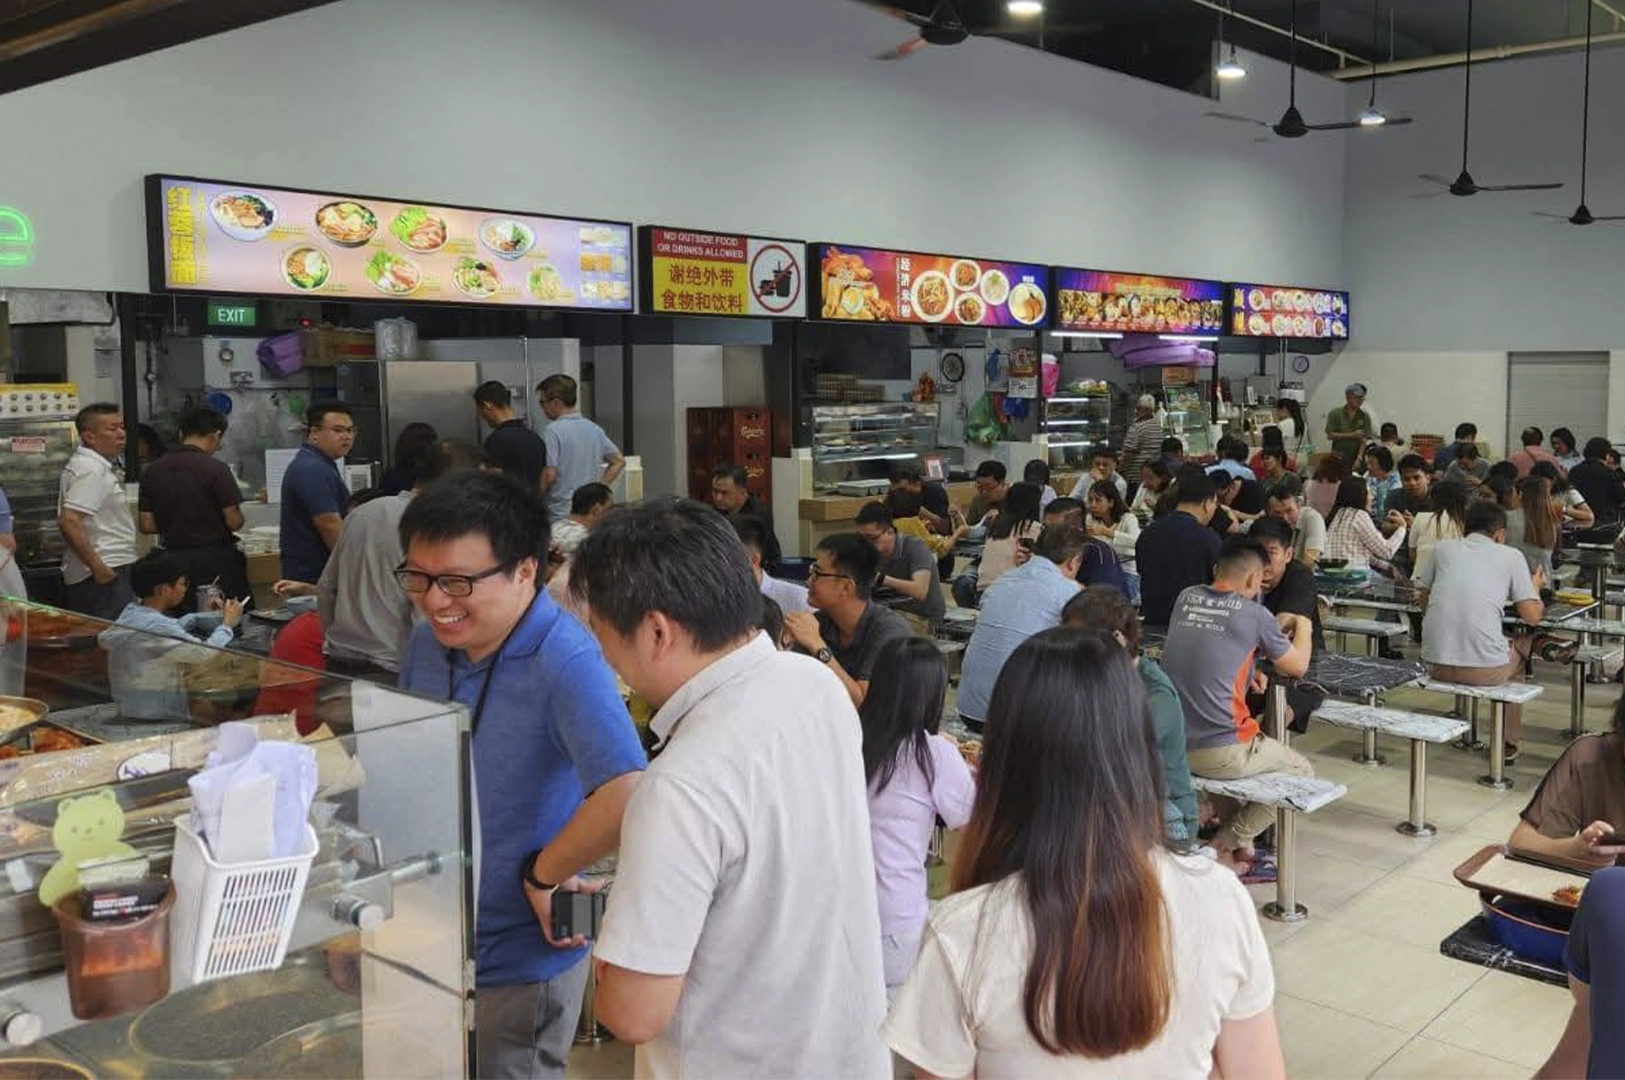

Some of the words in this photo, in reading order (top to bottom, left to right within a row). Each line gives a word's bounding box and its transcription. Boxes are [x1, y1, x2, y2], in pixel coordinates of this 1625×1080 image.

[664, 232, 677, 241] NO
[678, 232, 714, 244] OUTSIDE
[716, 237, 738, 246] FOOD
[657, 243, 671, 252] OR
[671, 244, 703, 256] DRINKS
[704, 247, 744, 259] ALLOWED
[669, 264, 733, 287] 谢绝外带
[662, 291, 742, 312] 食物和饮料
[217, 307, 245, 323] EXIT
